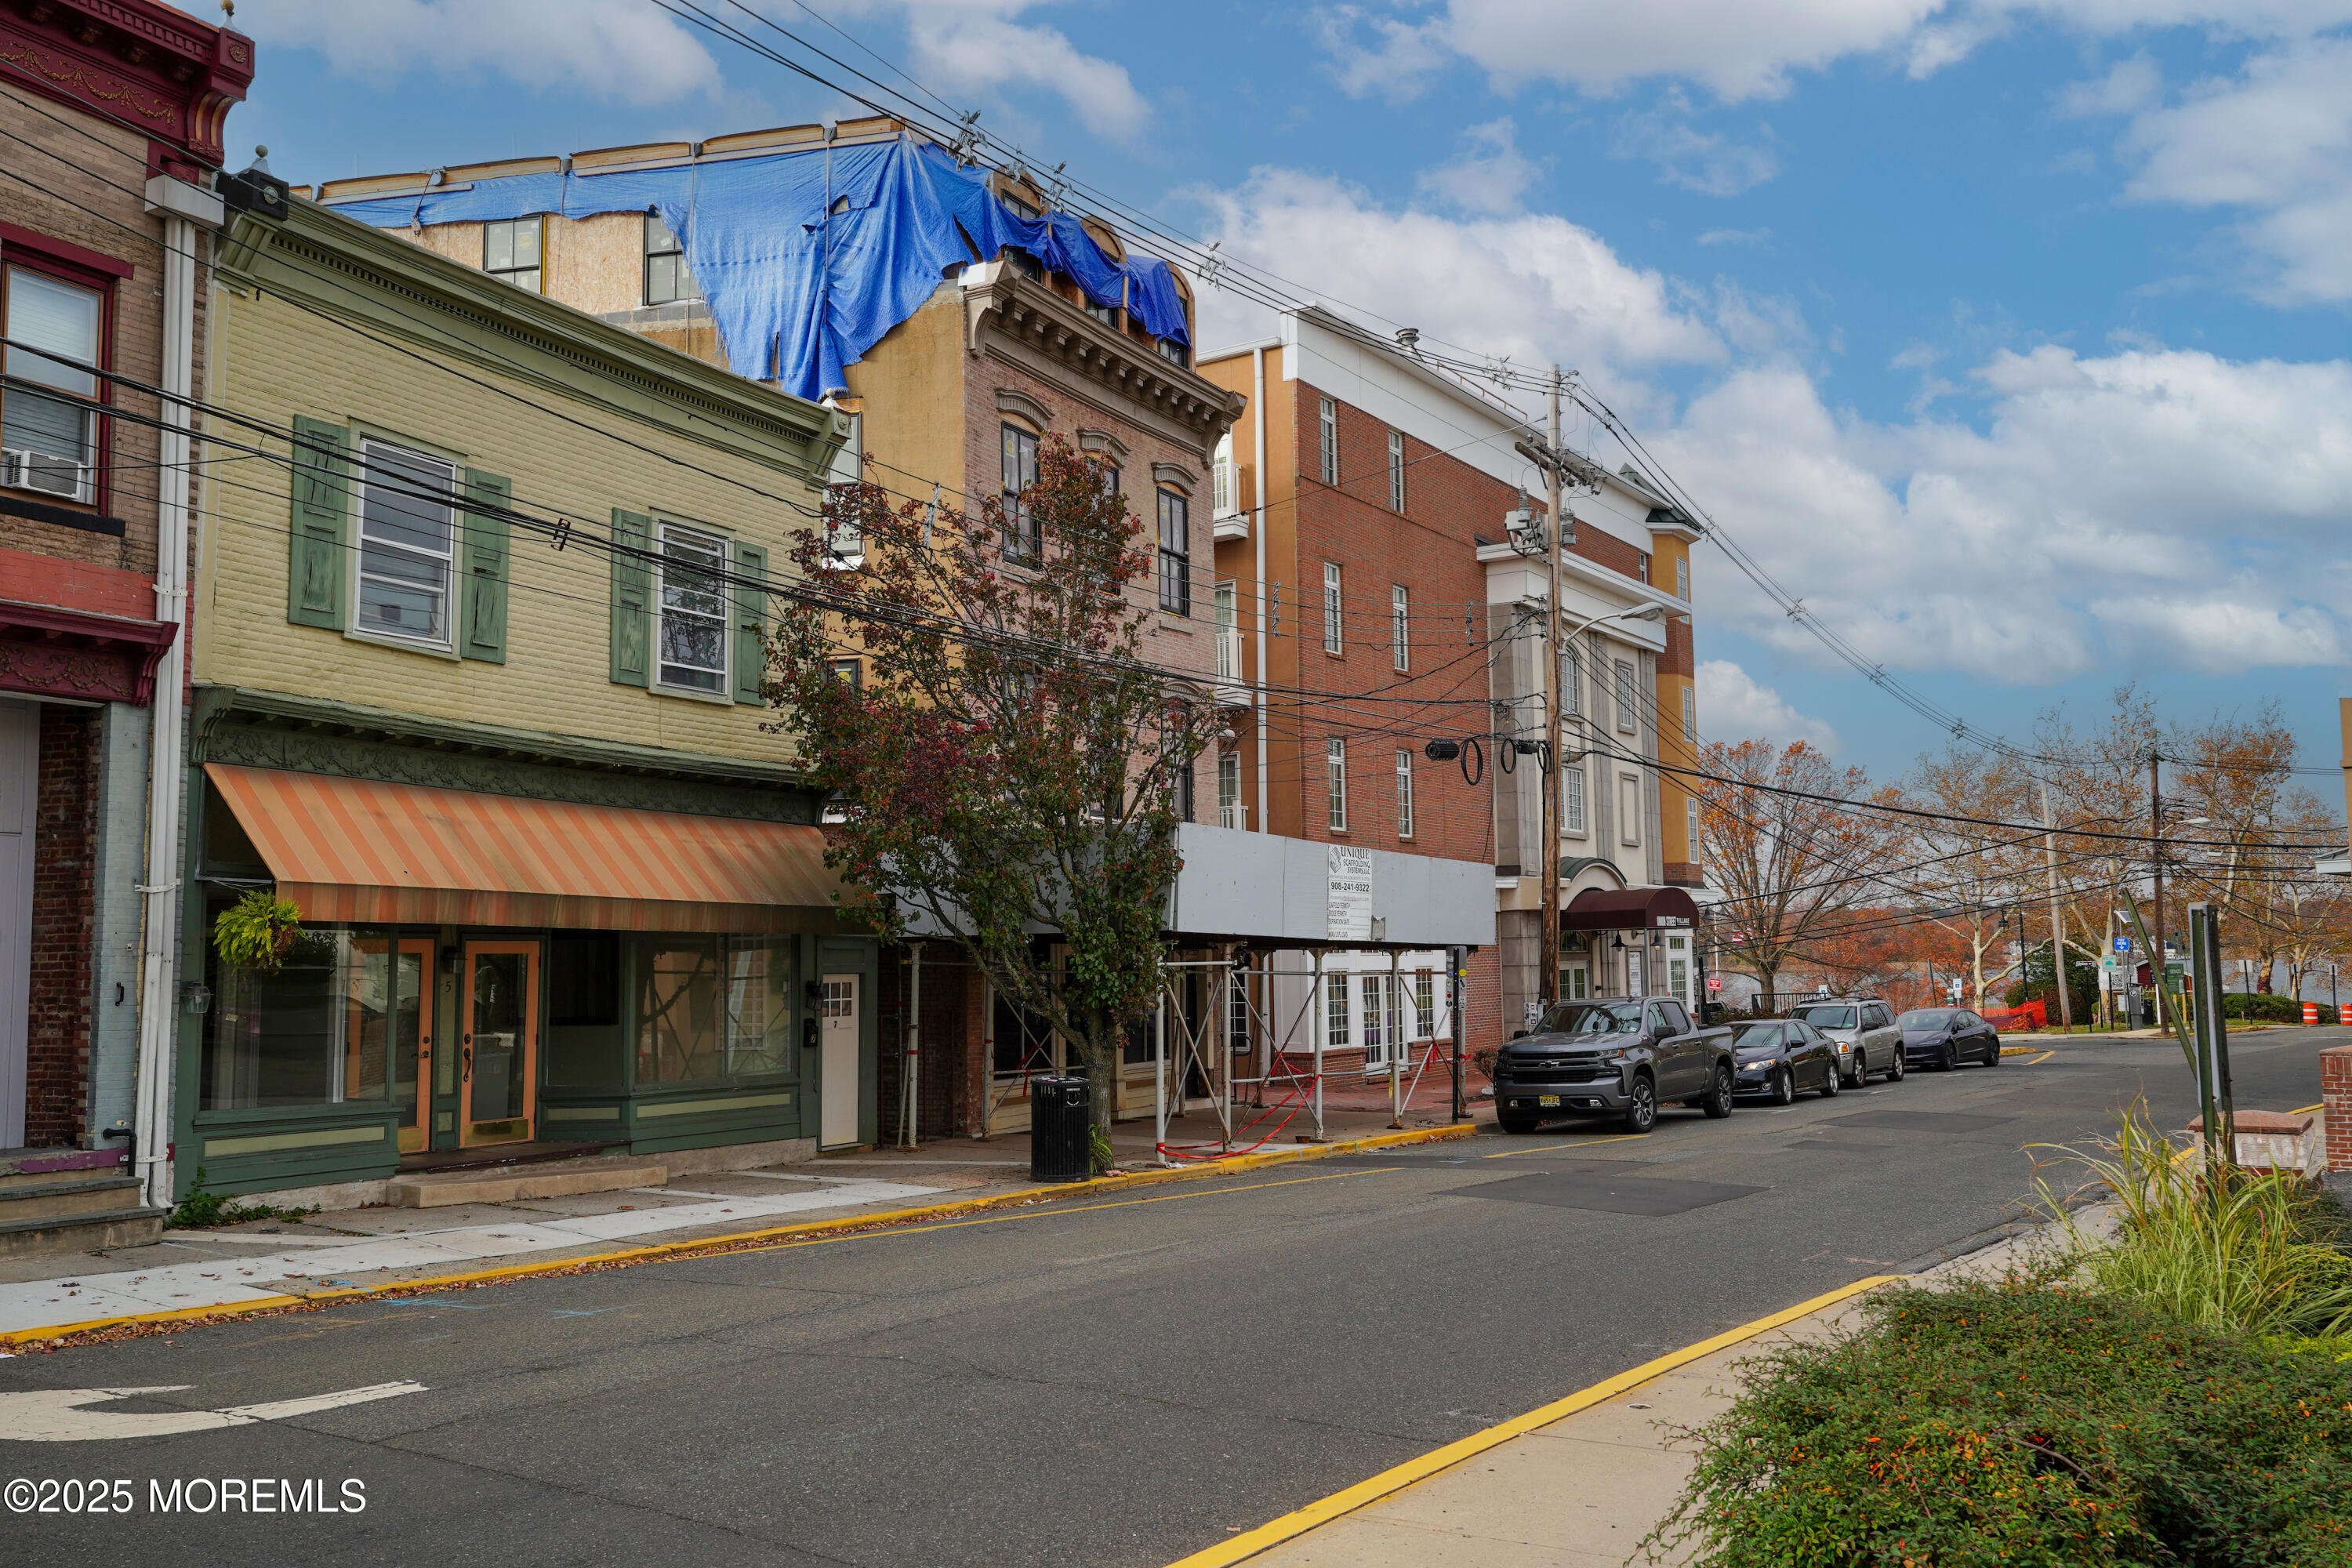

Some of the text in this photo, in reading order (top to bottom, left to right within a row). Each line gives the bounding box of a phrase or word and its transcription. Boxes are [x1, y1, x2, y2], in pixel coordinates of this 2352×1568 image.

[1341, 847, 1370, 859] UNIQUE
[1343, 858, 1370, 868] SCAFFOLDING
[1331, 882, 1369, 892] 908-241-9322
[1666, 916, 1677, 927] STREET
[445, 982, 452, 993] 5
